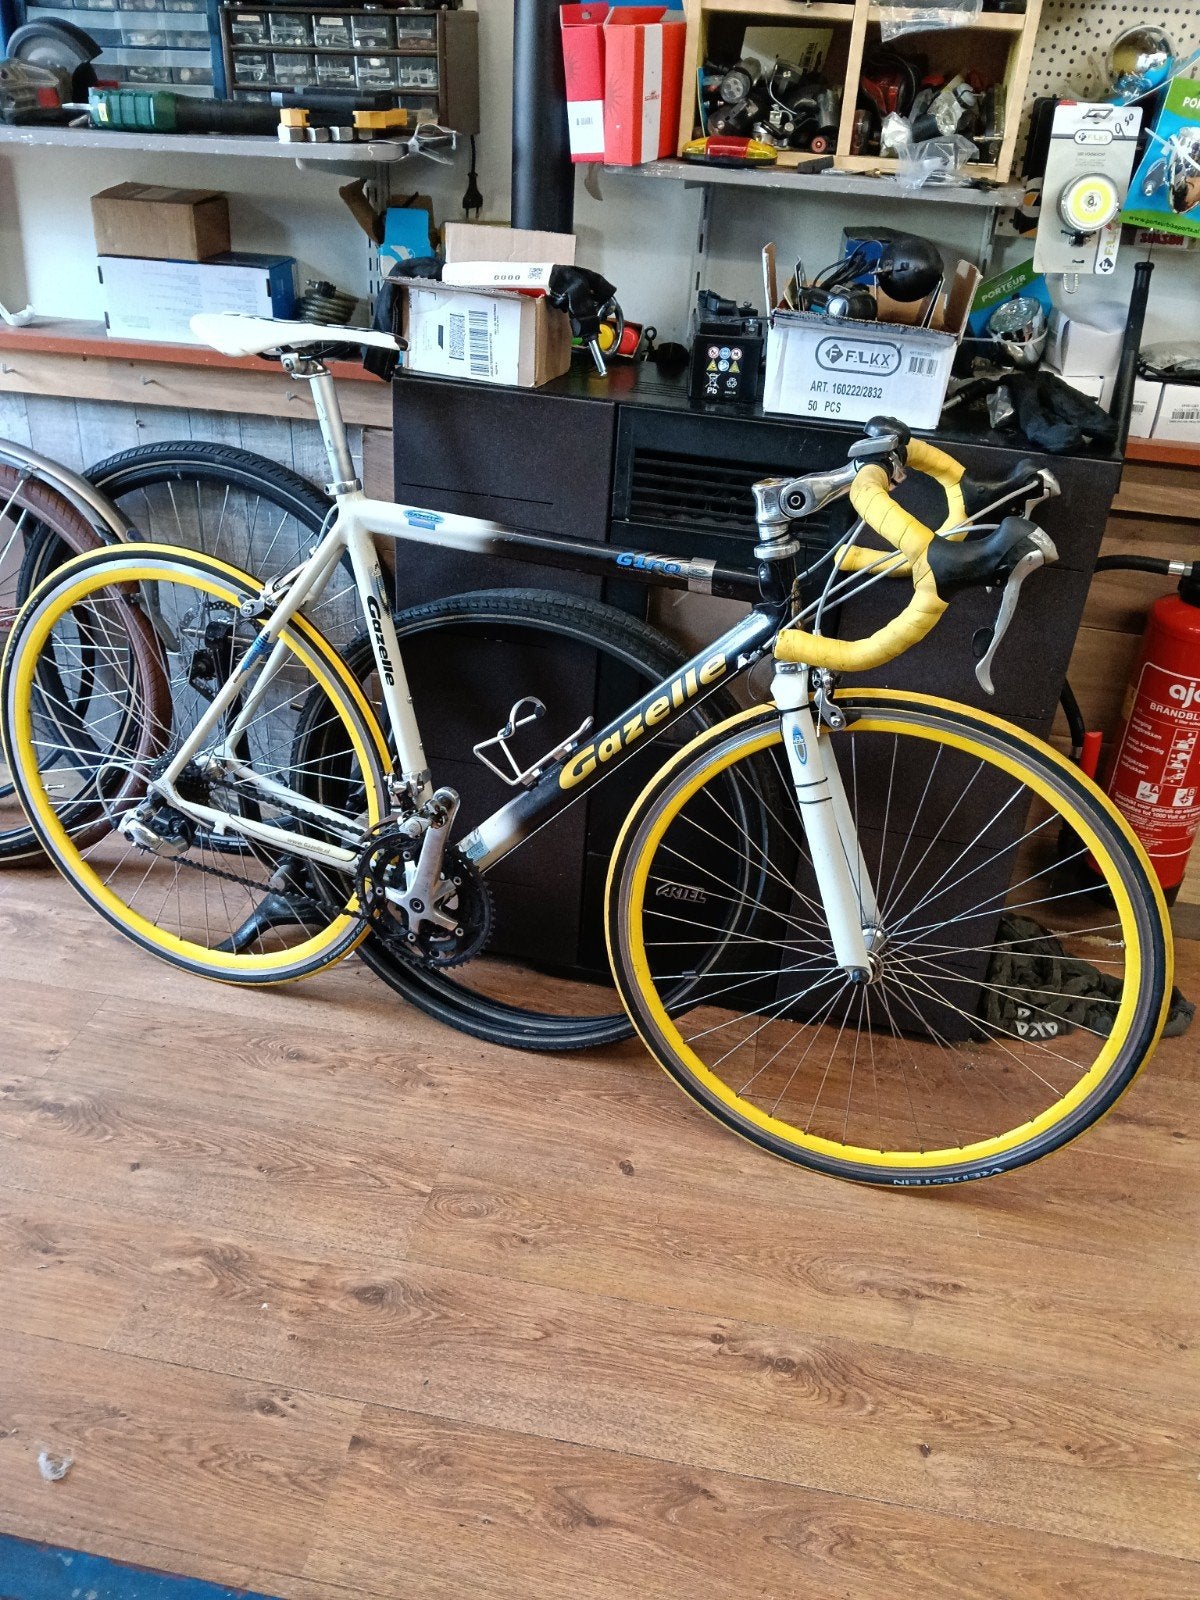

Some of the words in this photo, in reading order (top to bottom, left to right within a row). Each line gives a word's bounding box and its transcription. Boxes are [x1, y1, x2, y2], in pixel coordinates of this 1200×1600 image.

[982, 274, 1026, 302] PORTEUR
[810, 381, 829, 393] ART.
[832, 383, 882, 398] 160222/2832
[808, 400, 818, 411] 50
[824, 401, 841, 413] PCS
[367, 596, 395, 686] Gazelle
[559, 653, 727, 789] Gazelle
[1150, 702, 1200, 720] BRANDBL
